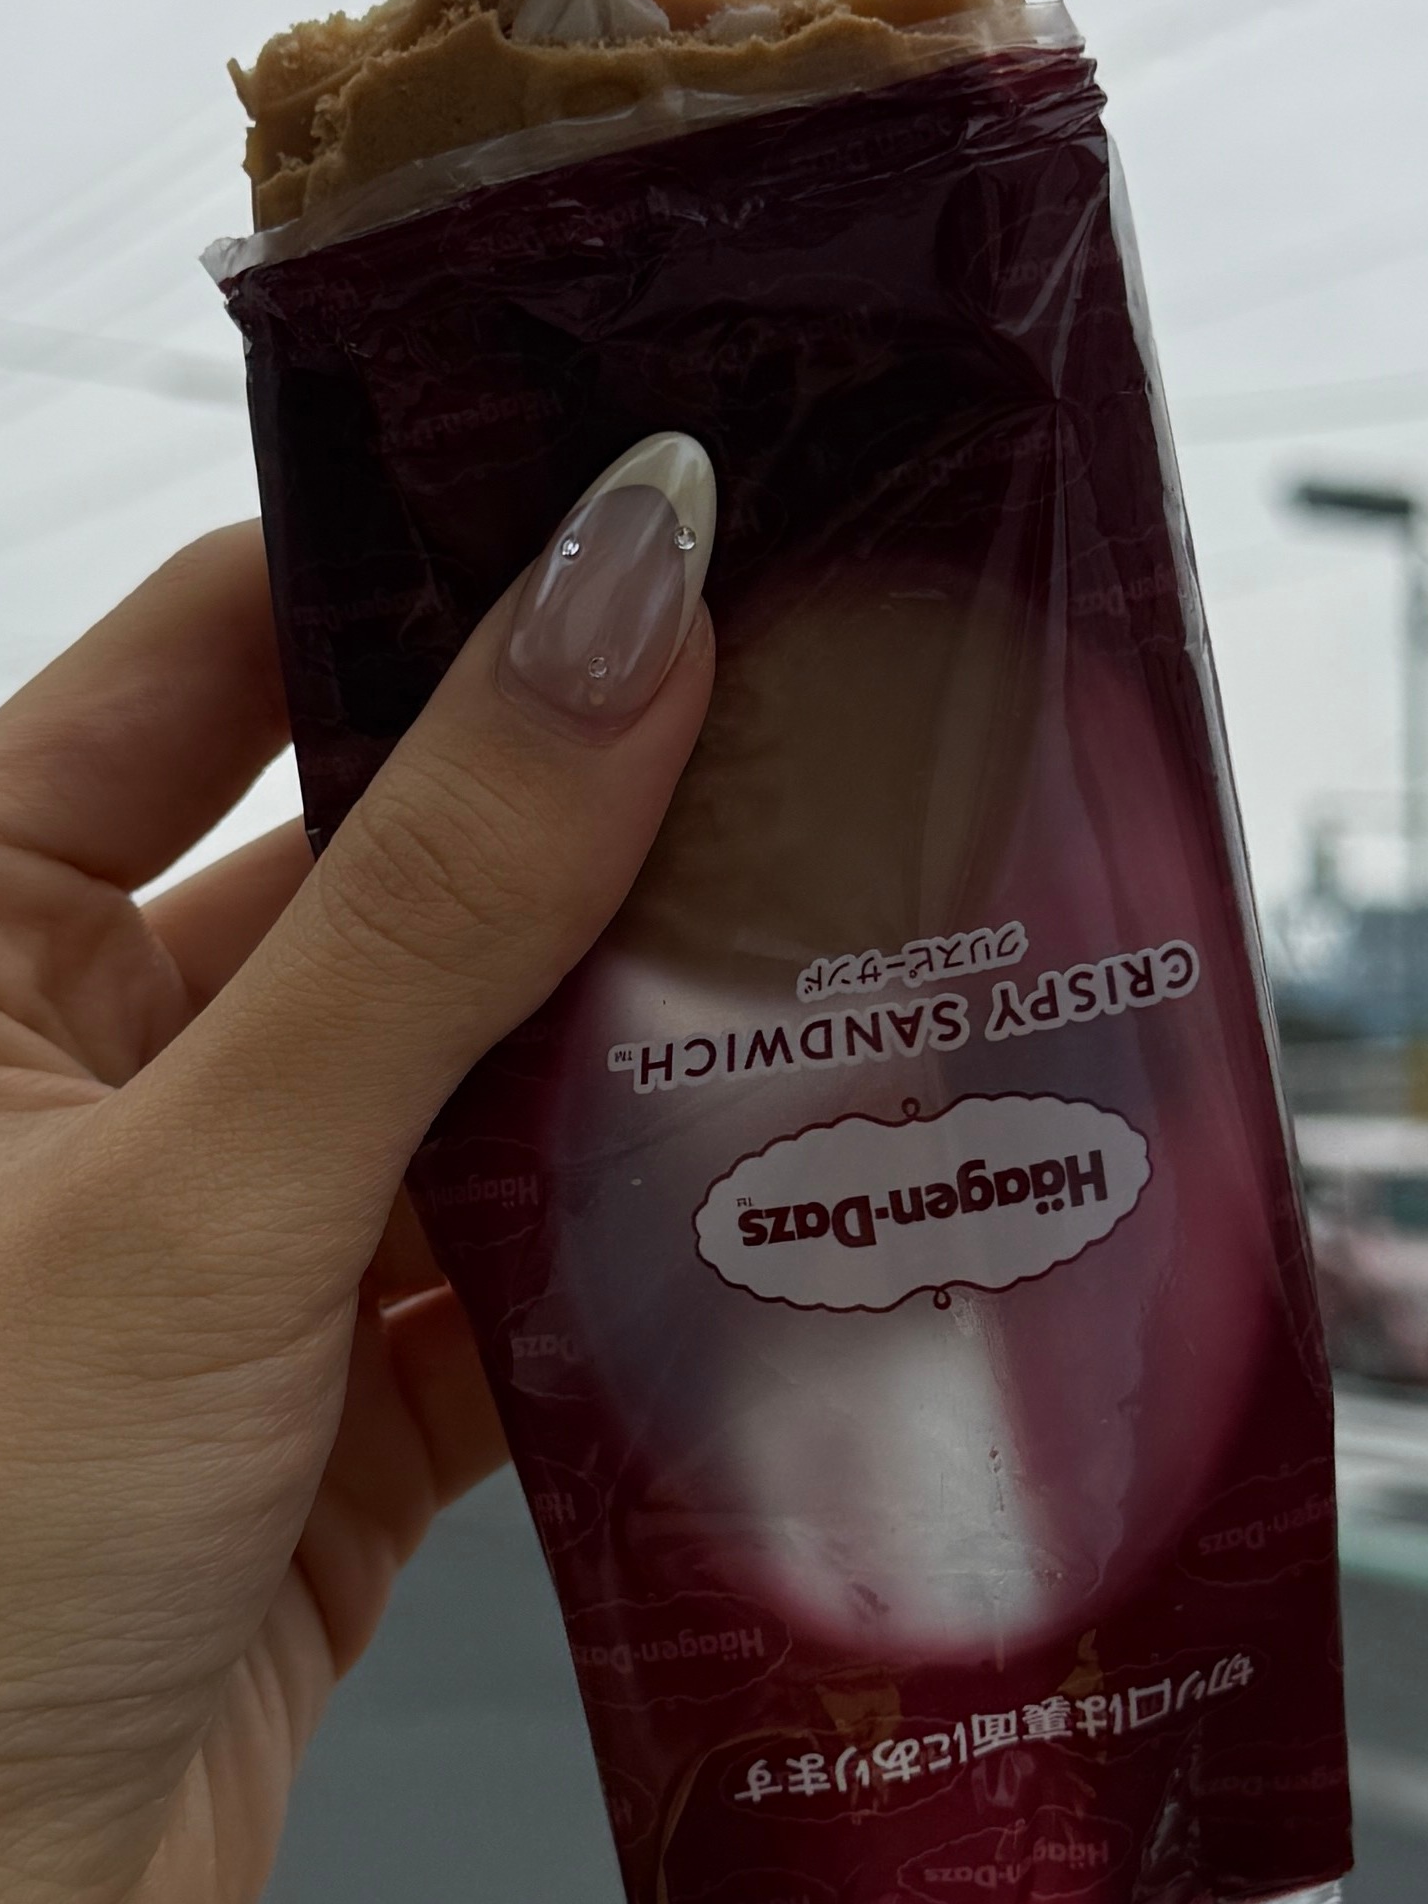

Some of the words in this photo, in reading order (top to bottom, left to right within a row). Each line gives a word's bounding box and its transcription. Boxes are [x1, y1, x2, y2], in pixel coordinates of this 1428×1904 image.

[803, 930, 1021, 995] クリスピーサンド
[991, 947, 1193, 1033] CRISPY
[737, 1149, 1105, 1249] Häagen-Dazs
[732, 1652, 1255, 1804] 切り口は裏面にあります
